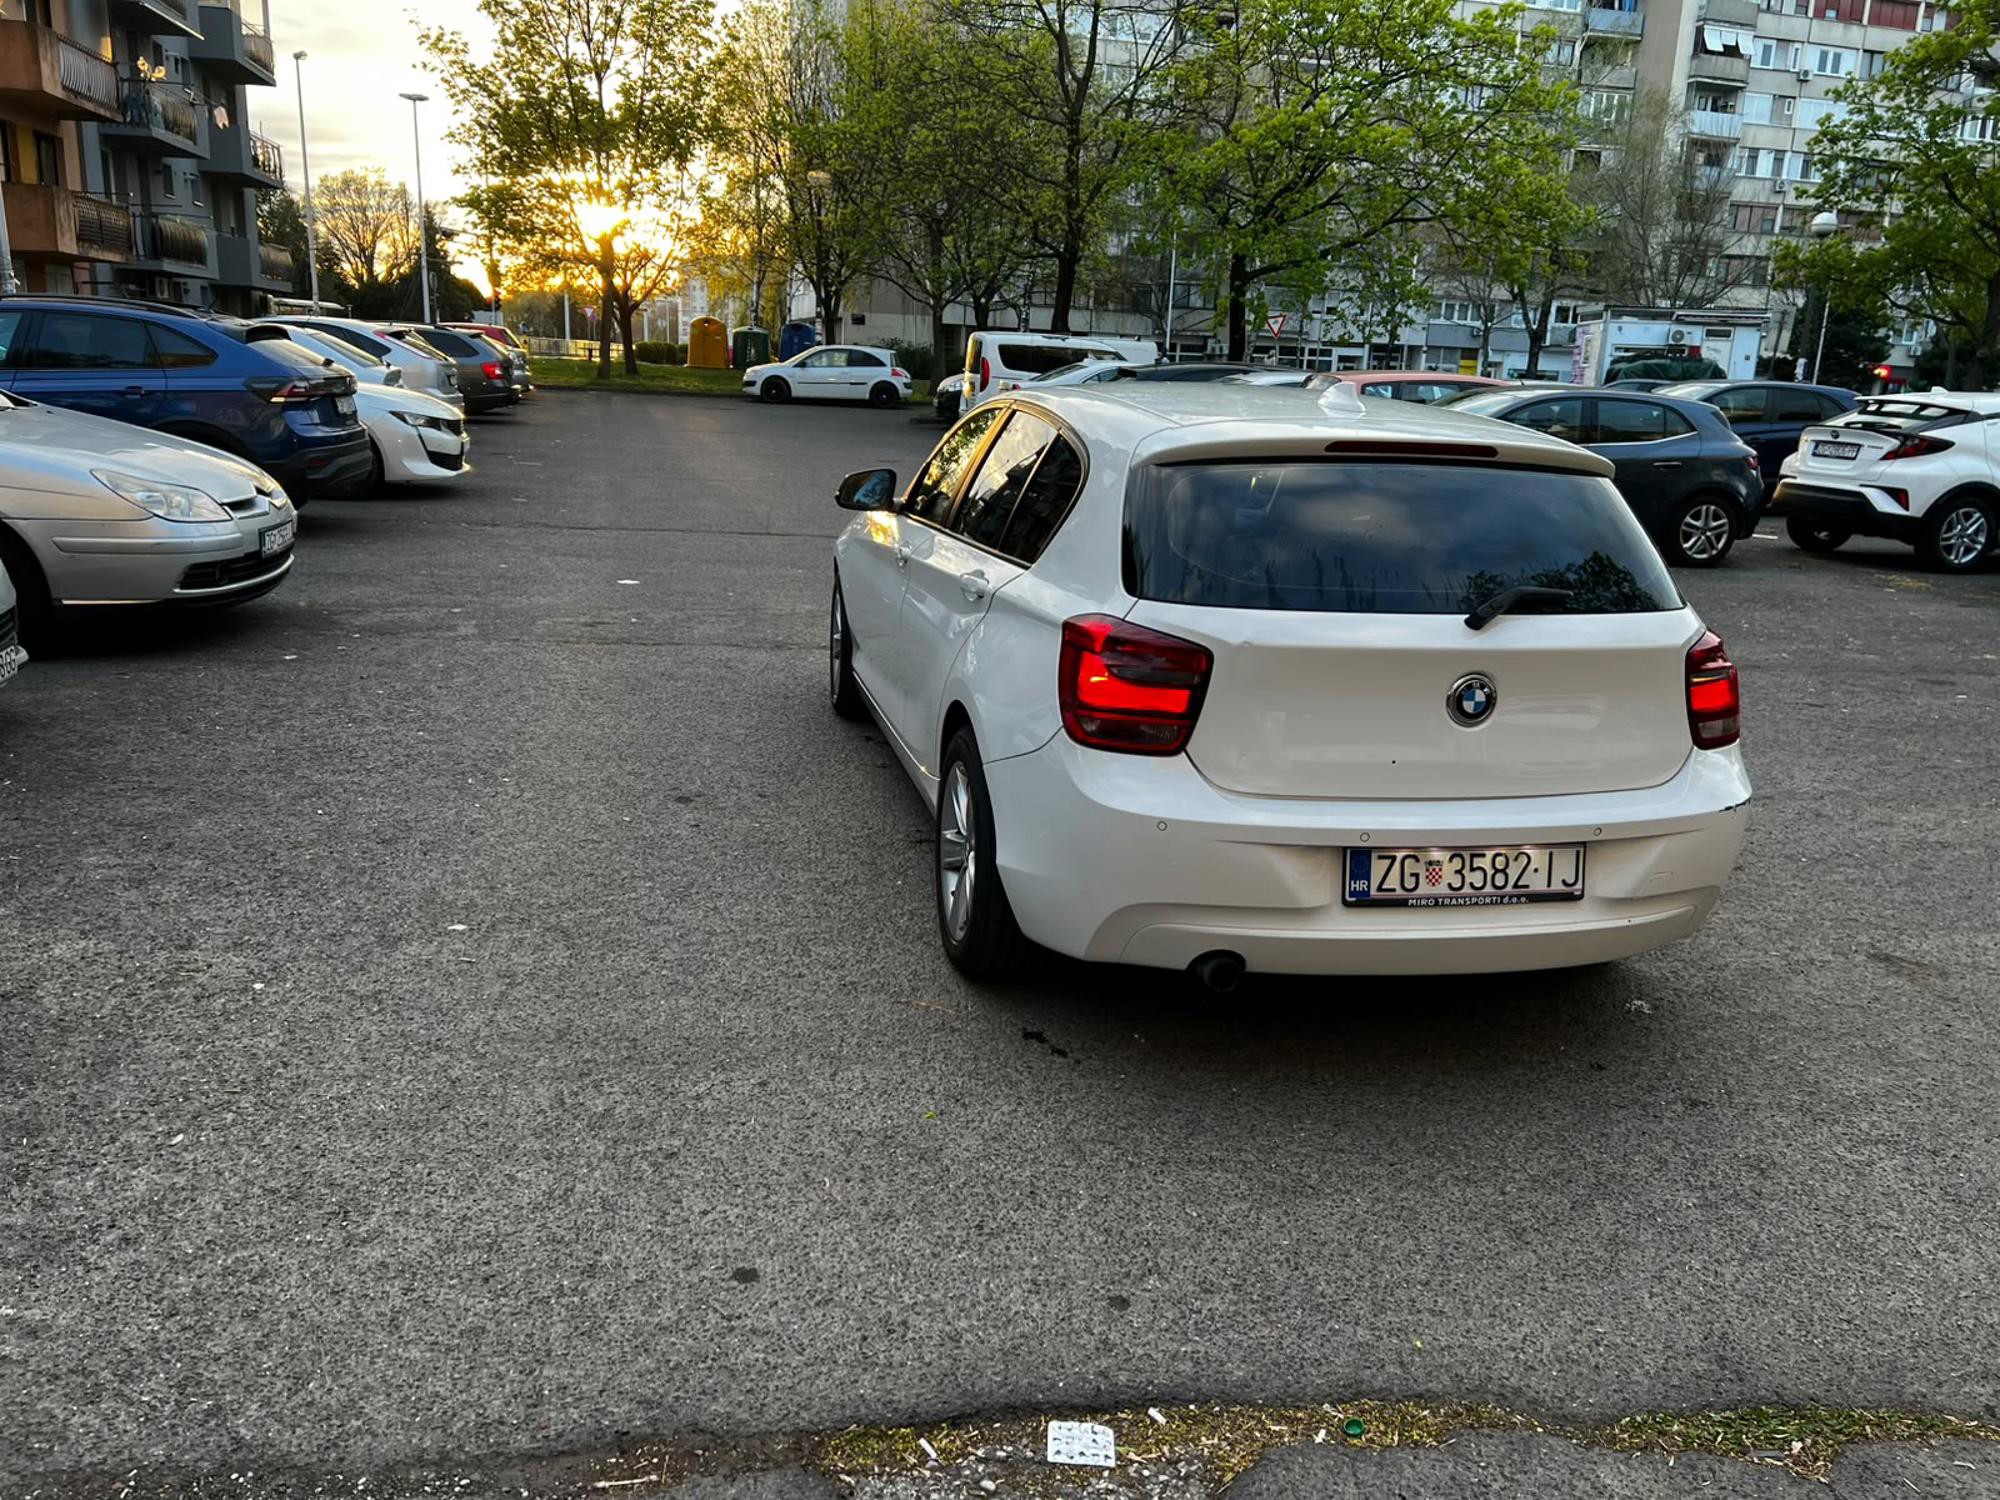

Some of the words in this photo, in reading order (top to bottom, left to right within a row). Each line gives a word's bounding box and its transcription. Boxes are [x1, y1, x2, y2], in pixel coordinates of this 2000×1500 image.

[1376, 854, 1421, 893] ZG
[1350, 879, 1369, 892] HR
[1408, 898, 1435, 907] MIRO
[1437, 896, 1501, 906] TRANSPORTI
